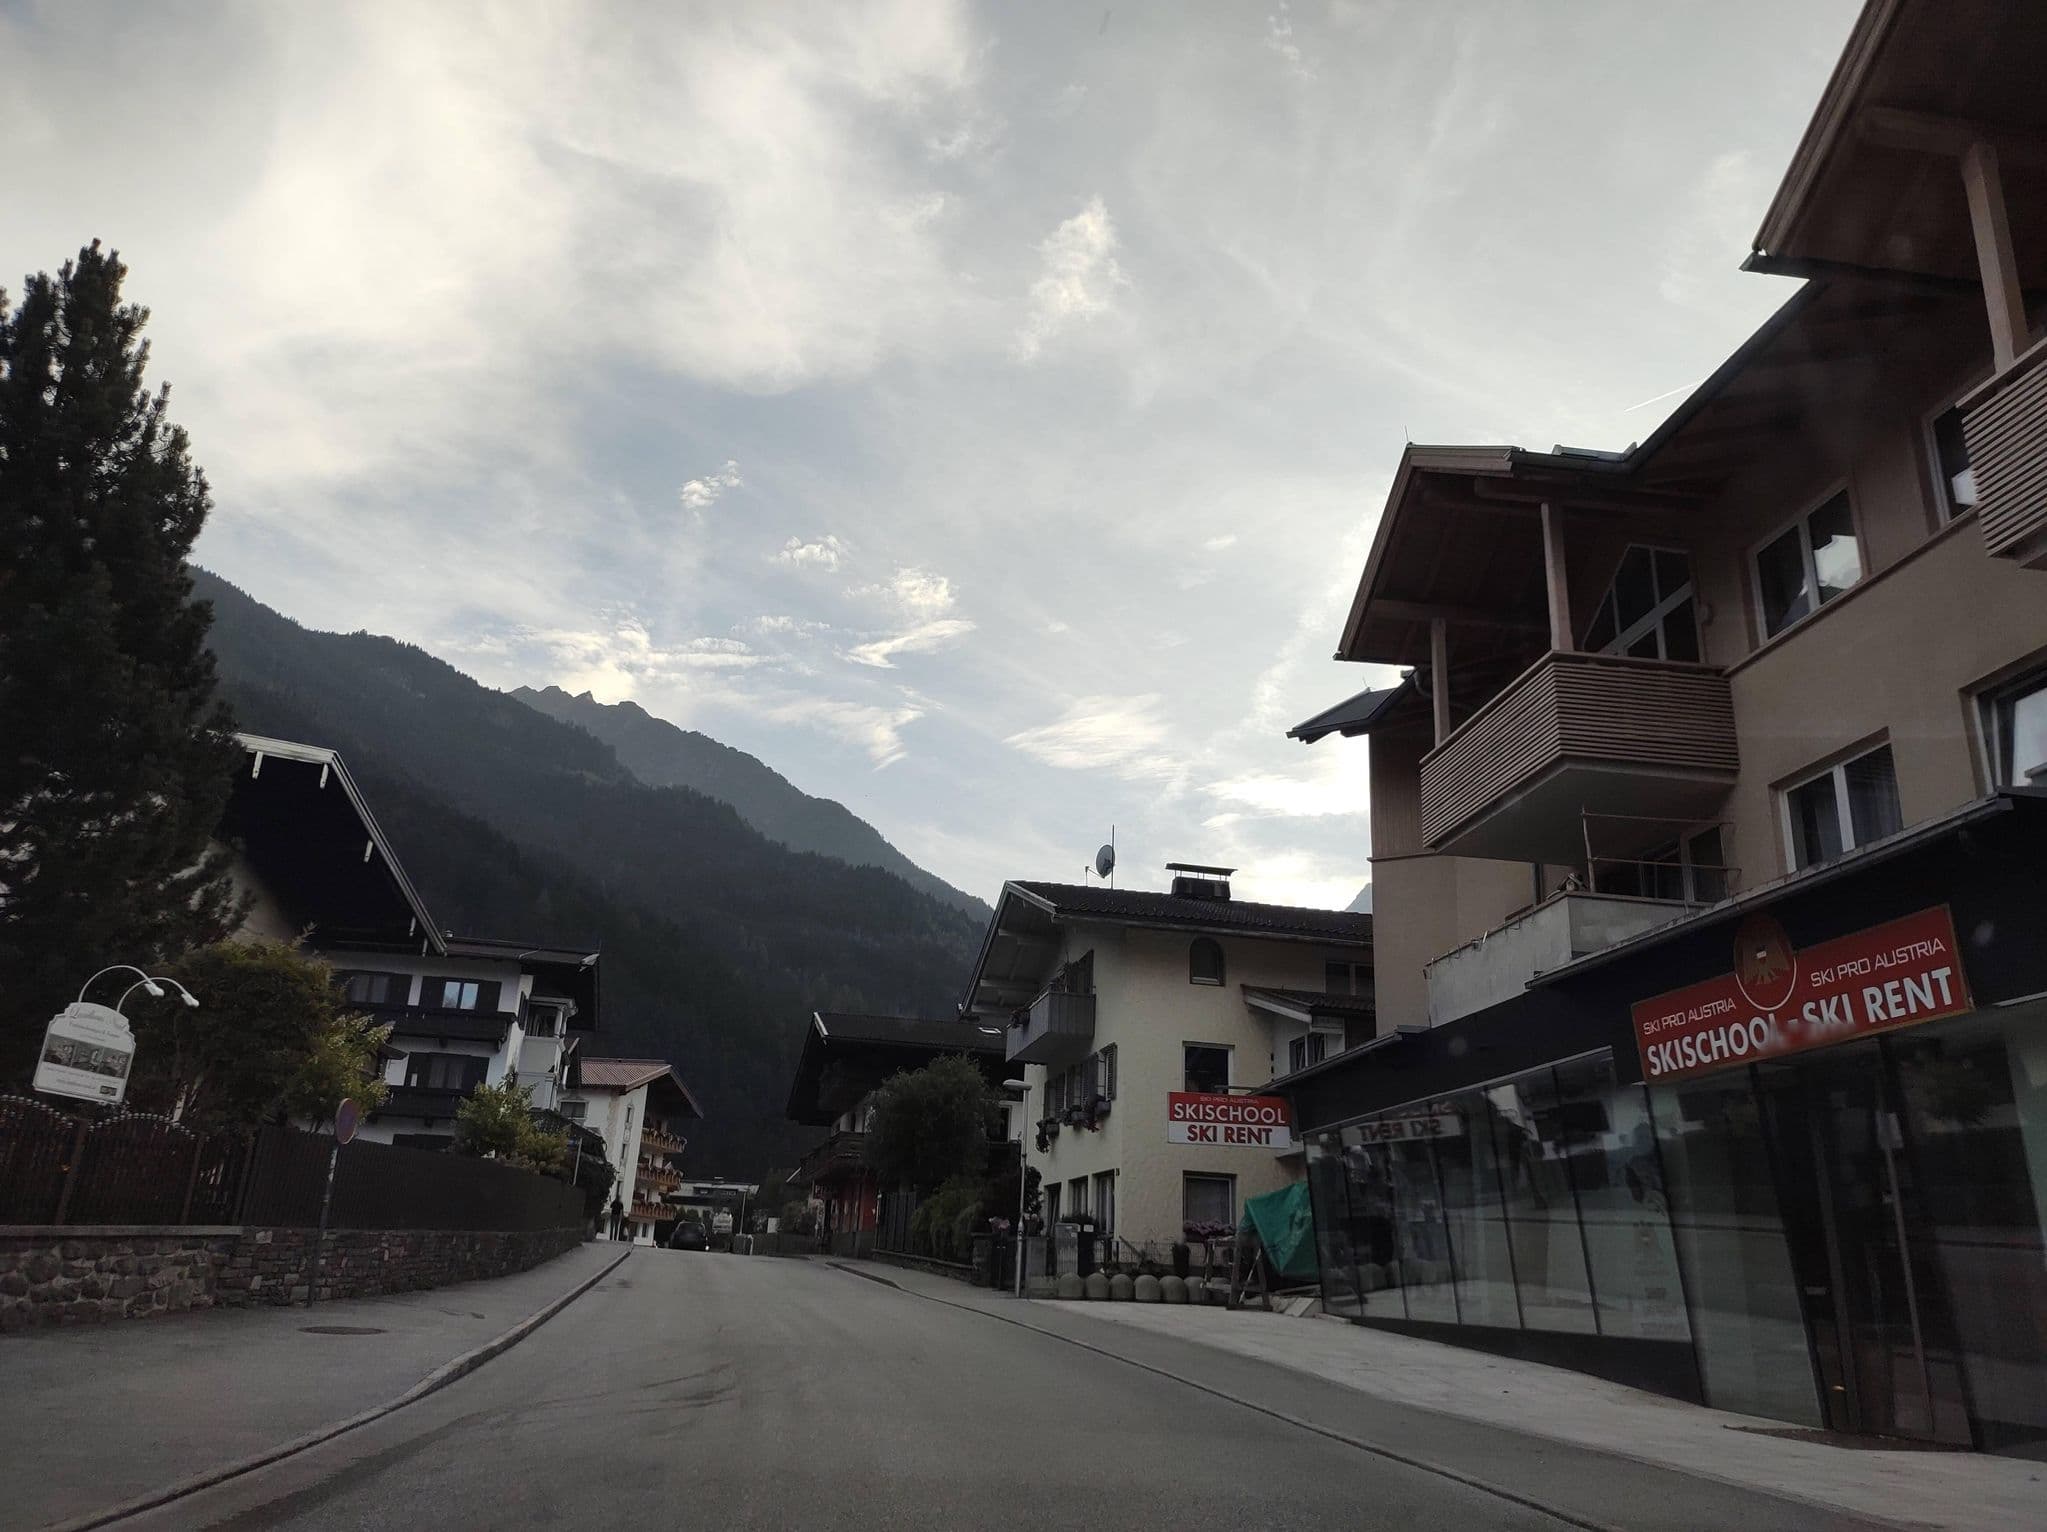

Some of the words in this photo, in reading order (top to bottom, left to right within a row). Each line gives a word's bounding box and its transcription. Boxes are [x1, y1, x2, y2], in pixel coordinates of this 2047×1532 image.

[1810, 970, 1835, 987] SKI
[1837, 957, 1871, 980] PRO
[1874, 937, 1946, 971] AUSTRIA
[1862, 966, 1952, 1023] RENT
[1642, 1019, 1661, 1035] SKI
[1661, 1012, 1687, 1030] PRO
[1688, 998, 1737, 1023] AUSTRIA
[1174, 1103, 1285, 1124] SKISCHOOL
[1187, 1124, 1217, 1142] SKI
[1224, 1126, 1273, 1145] RENT
